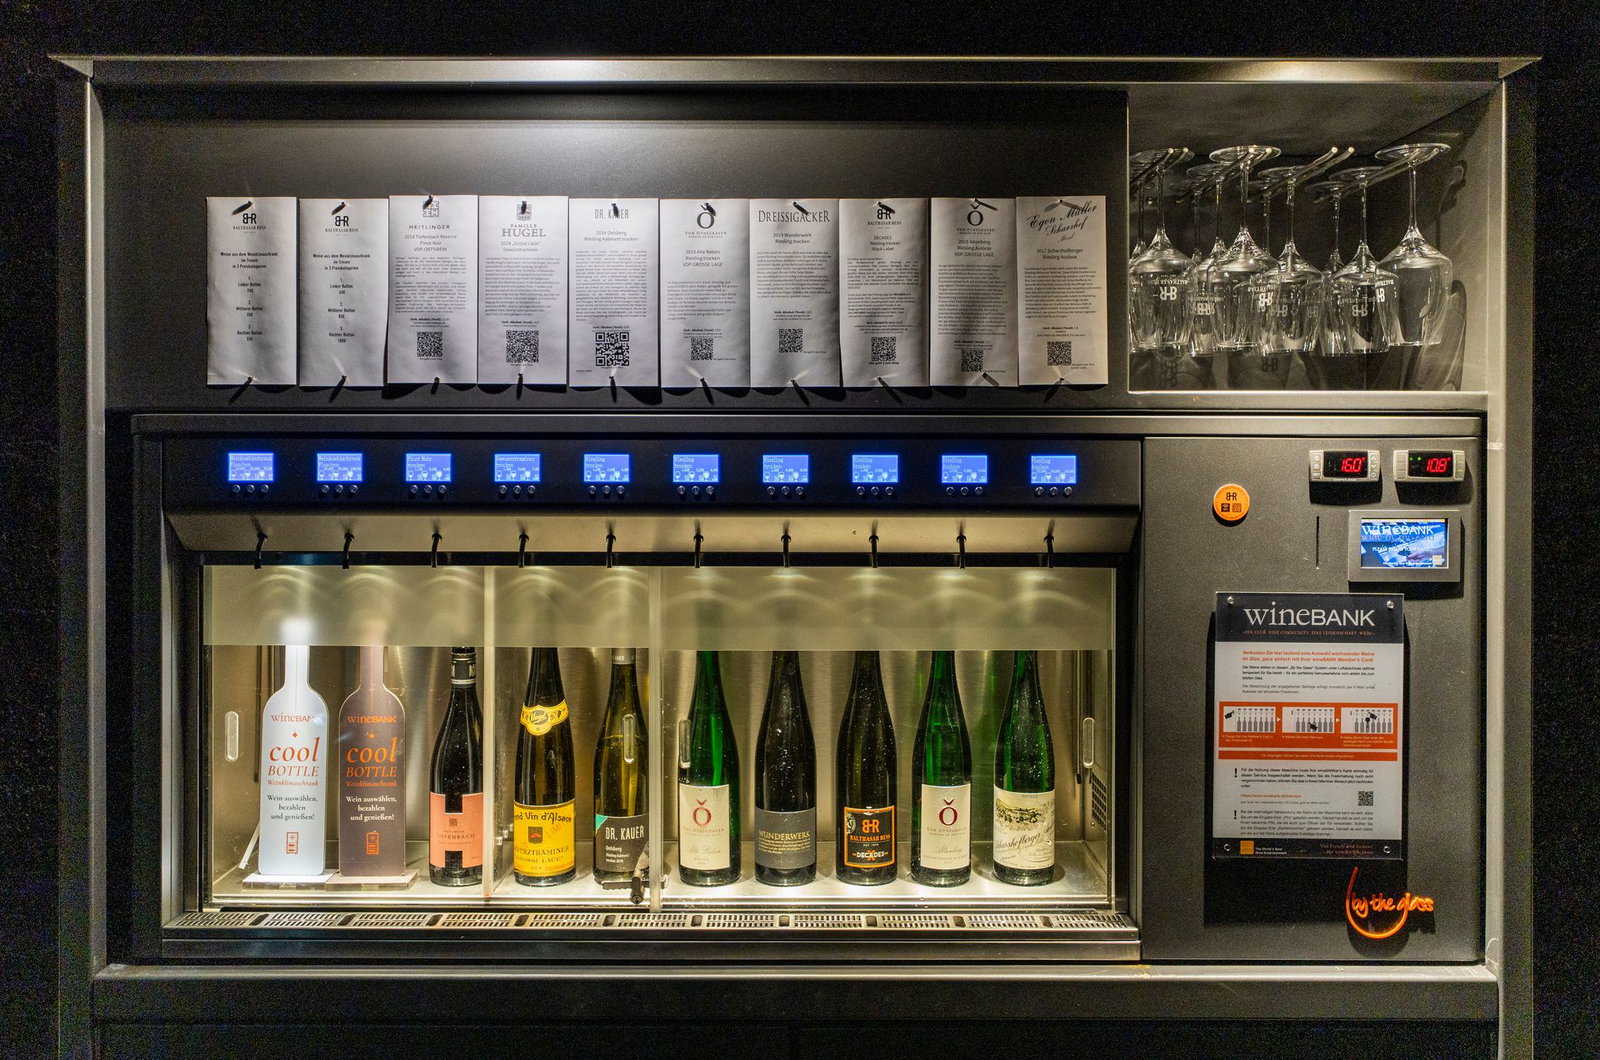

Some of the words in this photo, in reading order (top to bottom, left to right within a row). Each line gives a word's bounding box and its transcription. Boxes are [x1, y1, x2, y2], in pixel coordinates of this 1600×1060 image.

[758, 210, 830, 222] DREISSIGACKER
[1027, 214, 1056, 232] Egon
[501, 228, 546, 237] HUGEL
[1243, 601, 1375, 627] wineBANK
[269, 736, 320, 762] cool
[346, 737, 397, 763] cool
[268, 766, 319, 777] BOTTLE
[346, 767, 397, 777] BOTTLE
[271, 813, 283, 821] und
[350, 814, 362, 822] und
[525, 812, 538, 820] Vin
[605, 827, 618, 840] DR.
[620, 825, 645, 840] KAUER
[1351, 892, 1369, 918] by
[1369, 892, 1395, 912] the
